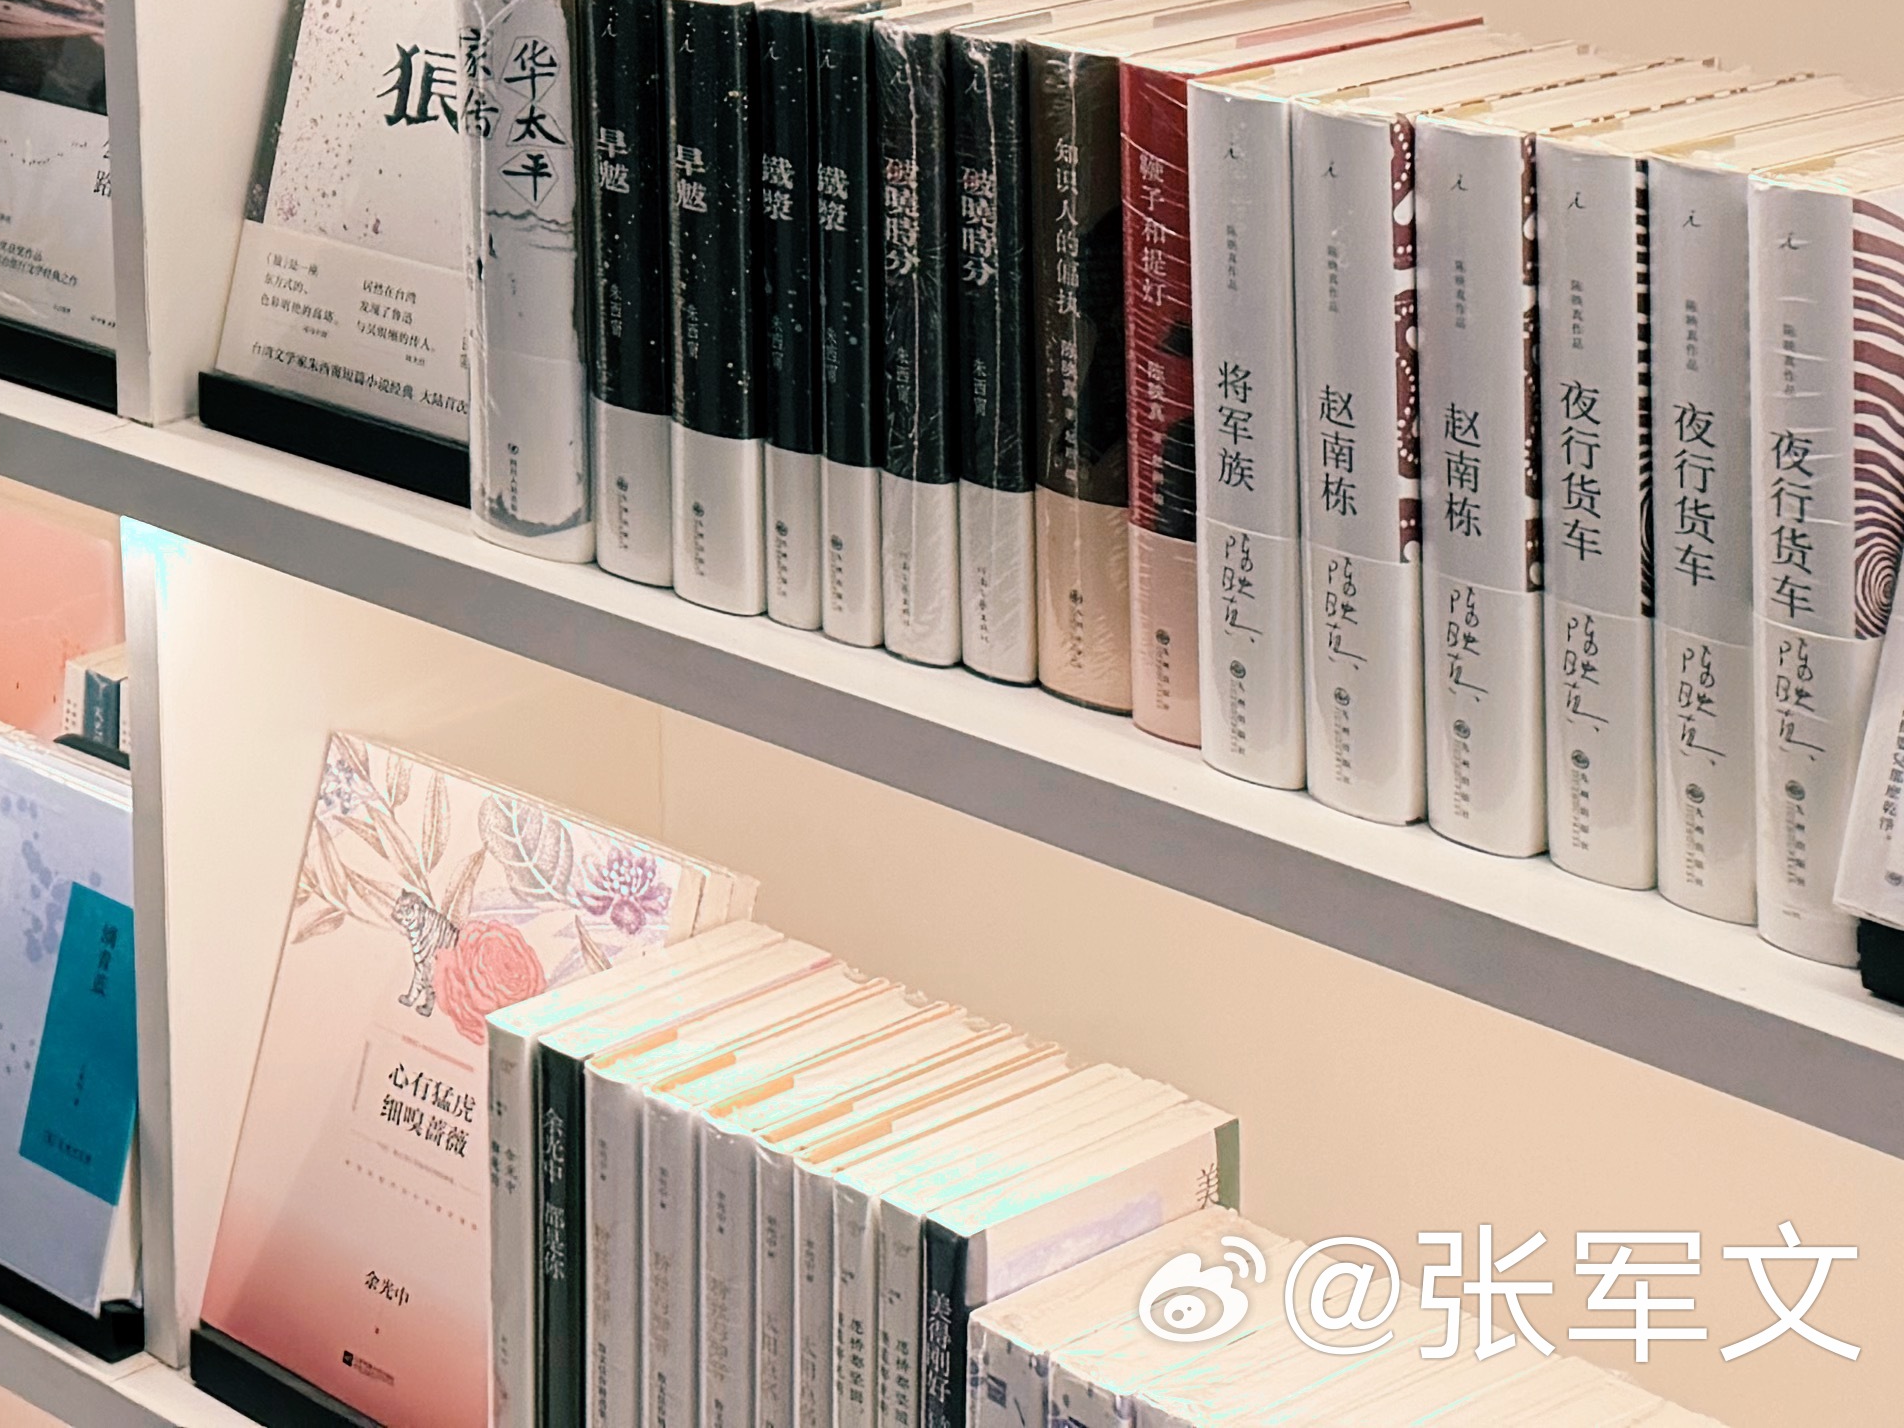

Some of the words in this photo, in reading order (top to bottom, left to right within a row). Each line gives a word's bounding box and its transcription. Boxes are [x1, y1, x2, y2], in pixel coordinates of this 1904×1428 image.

[376, 41, 461, 135] 狼
[459, 27, 501, 138] 家传
[503, 38, 566, 203] 华太平
[597, 126, 631, 195] 旱魃
[674, 144, 708, 214] 旱魃
[760, 152, 795, 223] 鐵漿
[816, 161, 850, 235] 鐵漿
[884, 156, 921, 278] 破曉時分
[959, 166, 998, 288] 破曉時分
[1052, 136, 1081, 321] 知识人的偏执
[1138, 152, 1169, 310] 鞭子和提灯
[1146, 359, 1167, 423] 陈映真
[1215, 359, 1256, 494] 将军族
[1317, 384, 1359, 518] 赵南栋
[1442, 402, 1483, 540] 赵南栋
[1558, 378, 1603, 562] 夜行货车
[1672, 400, 1718, 588] 夜行货车
[1770, 429, 1816, 619] 夜行货车
[379, 1093, 470, 1160] 细嗅蔷薇
[387, 1059, 477, 1125] 心有猛虎
[542, 1106, 566, 1186] 余光中
[362, 1268, 411, 1308] 余光中
